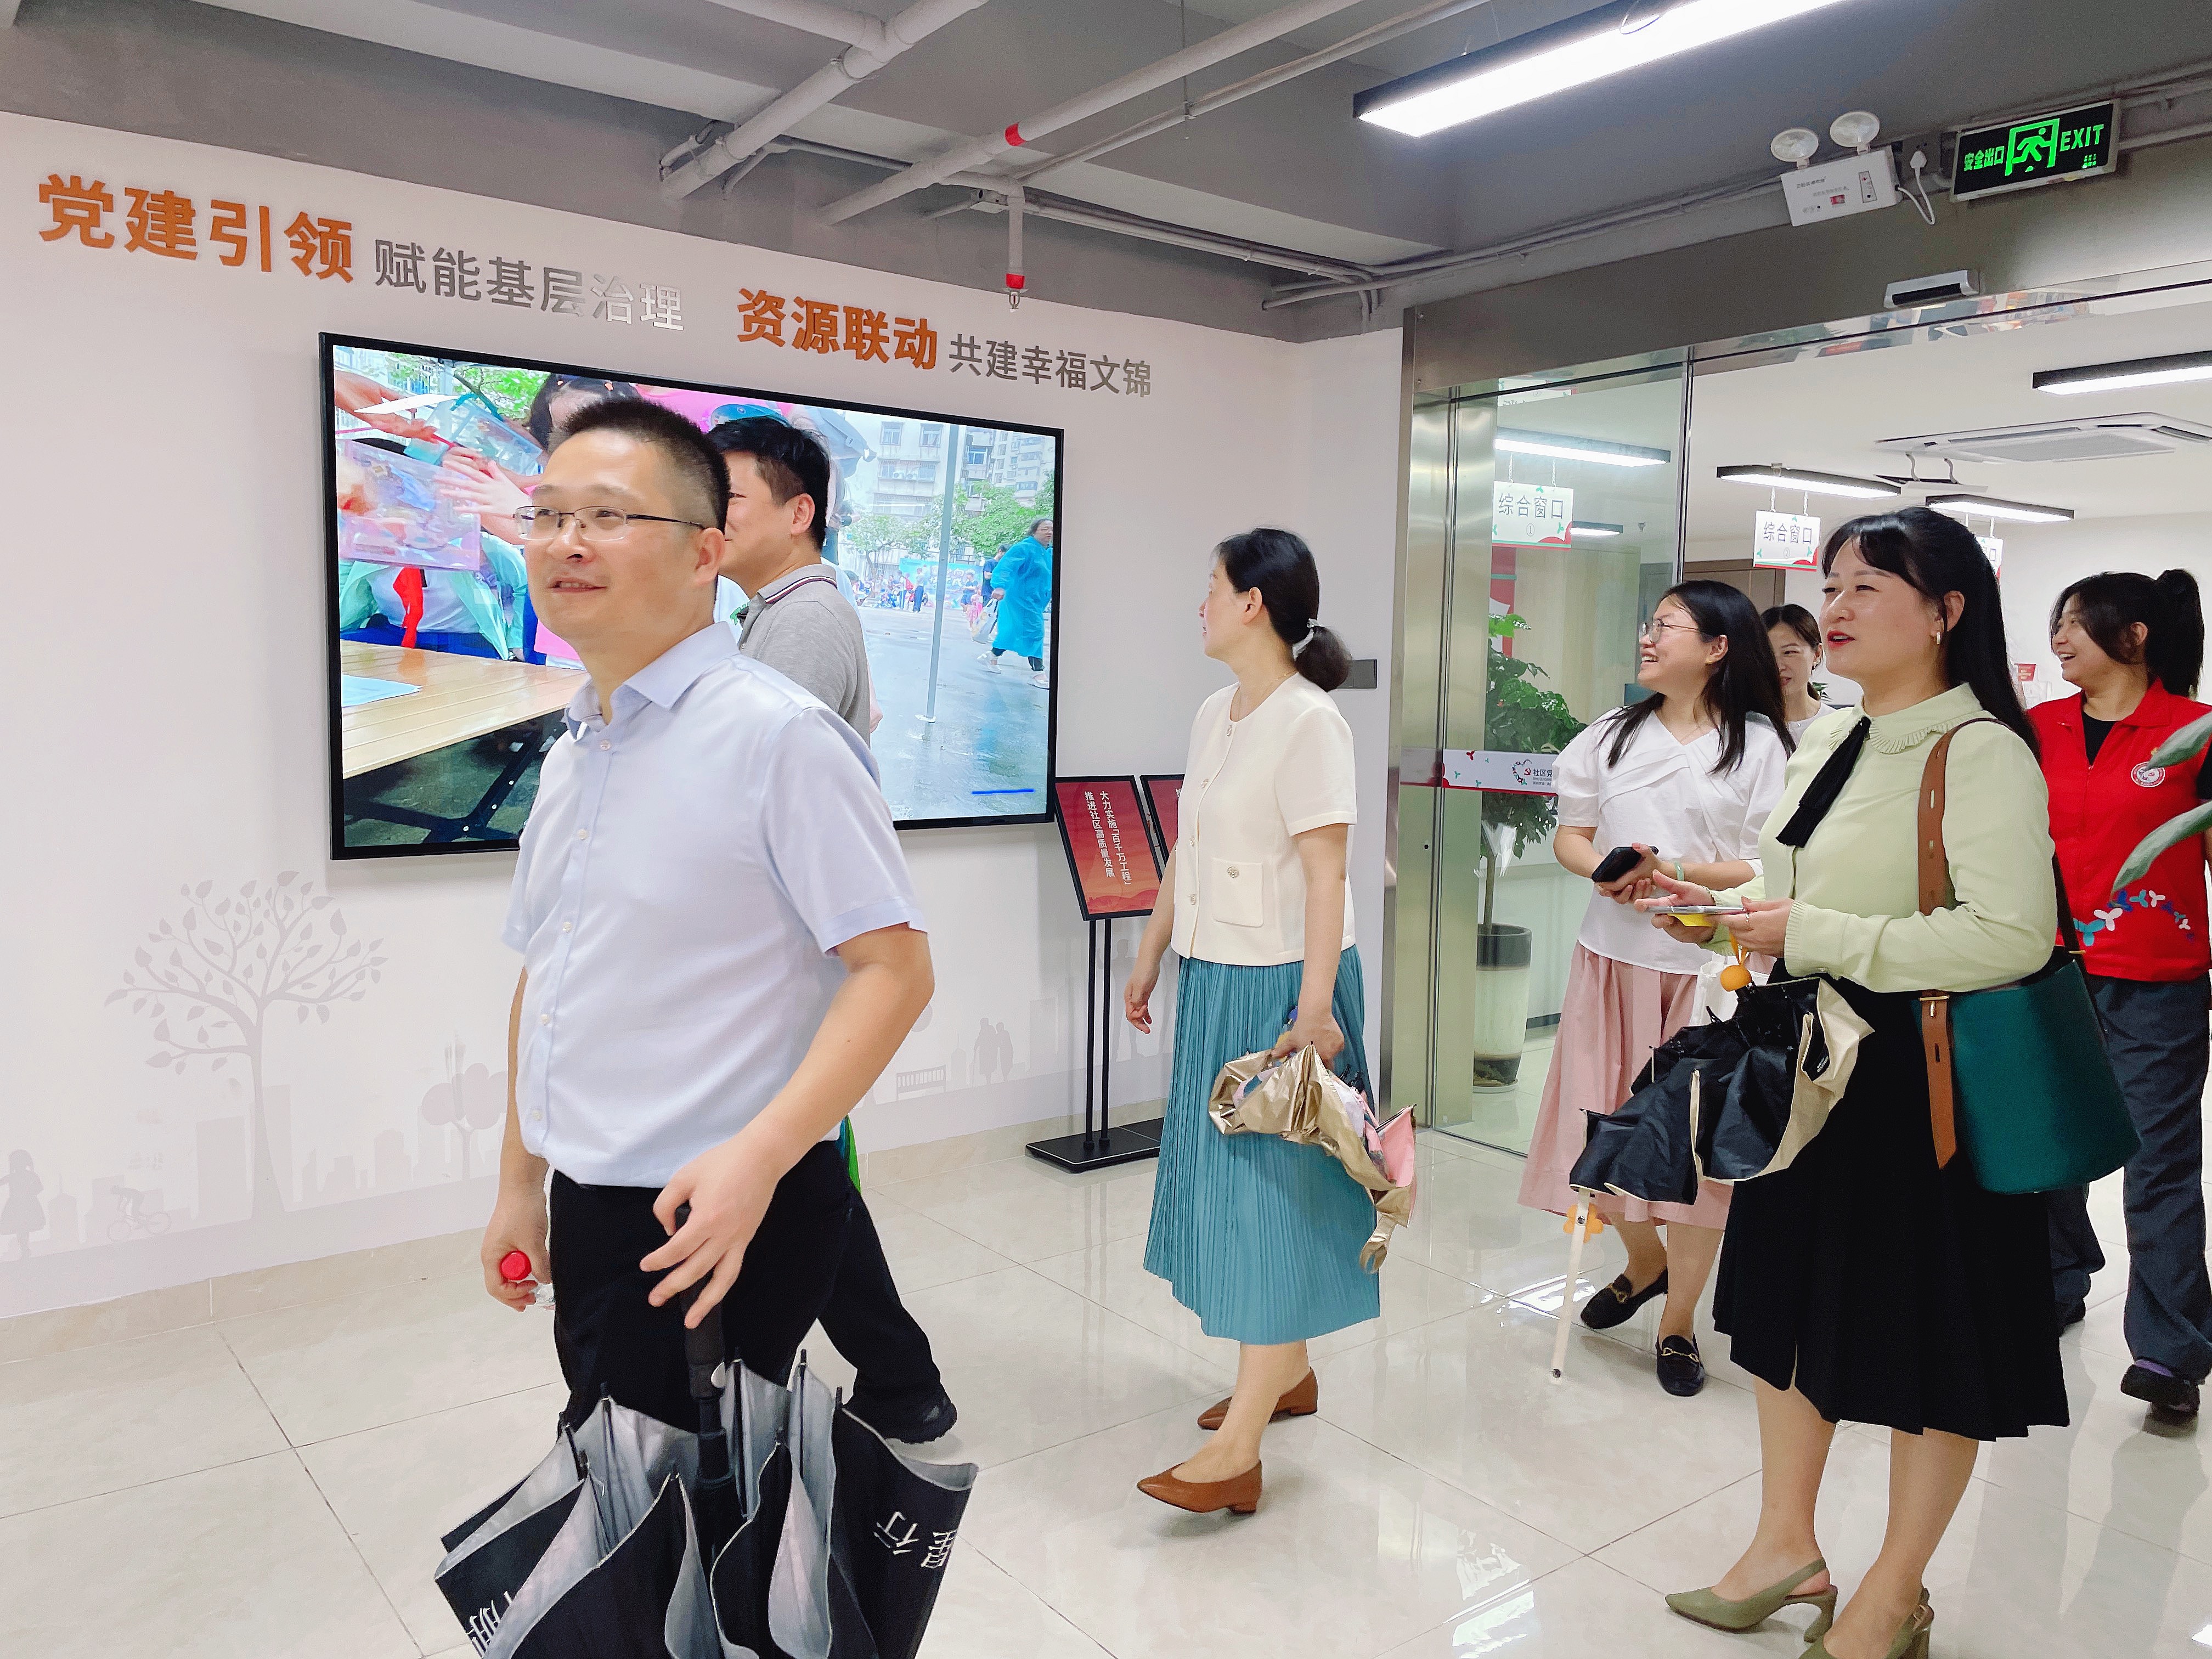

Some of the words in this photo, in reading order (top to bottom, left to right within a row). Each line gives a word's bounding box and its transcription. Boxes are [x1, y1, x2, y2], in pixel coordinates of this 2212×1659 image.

[2060, 124, 2104, 151] EXIT
[1964, 146, 2004, 171] 安全出口
[38, 173, 354, 284] 党建引领
[375, 239, 684, 331] 赋能基层治理
[737, 288, 937, 369] 资源联动
[949, 334, 1151, 397] 共建幸福文锦
[1498, 493, 1563, 520] 综合窗口
[1763, 521, 1812, 544] 综合窗口
[1084, 791, 1115, 878] 推进社区高质量发展
